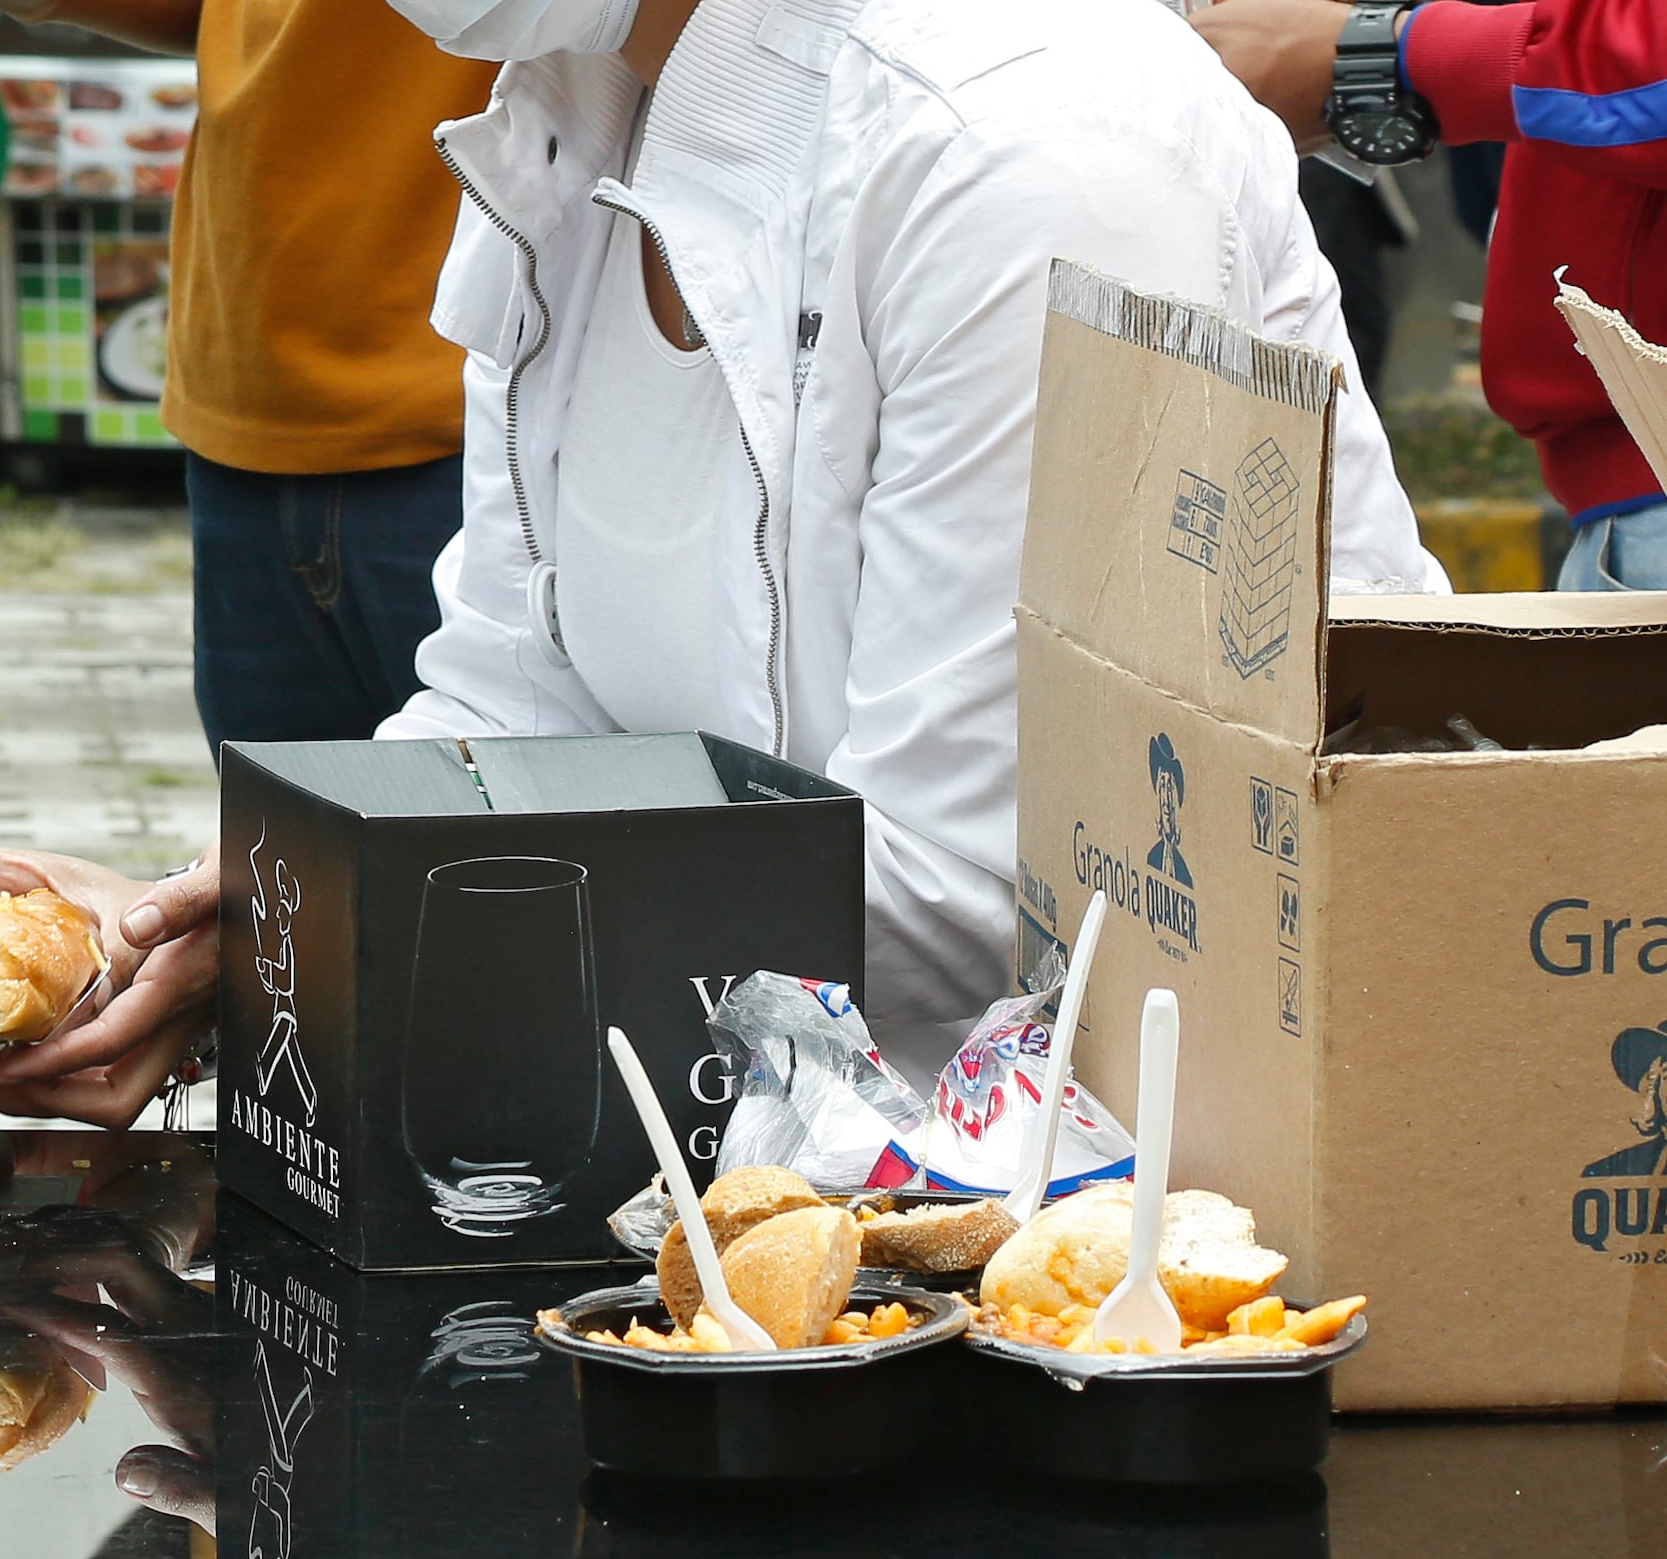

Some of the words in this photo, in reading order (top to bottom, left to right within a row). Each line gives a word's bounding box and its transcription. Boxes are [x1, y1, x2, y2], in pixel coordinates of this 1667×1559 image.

[1073, 820, 1141, 919] Granola
[1146, 875, 1199, 954] QUAKER
[231, 1089, 340, 1188] AMBIENTE
[286, 1166, 340, 1219] GOURMET
